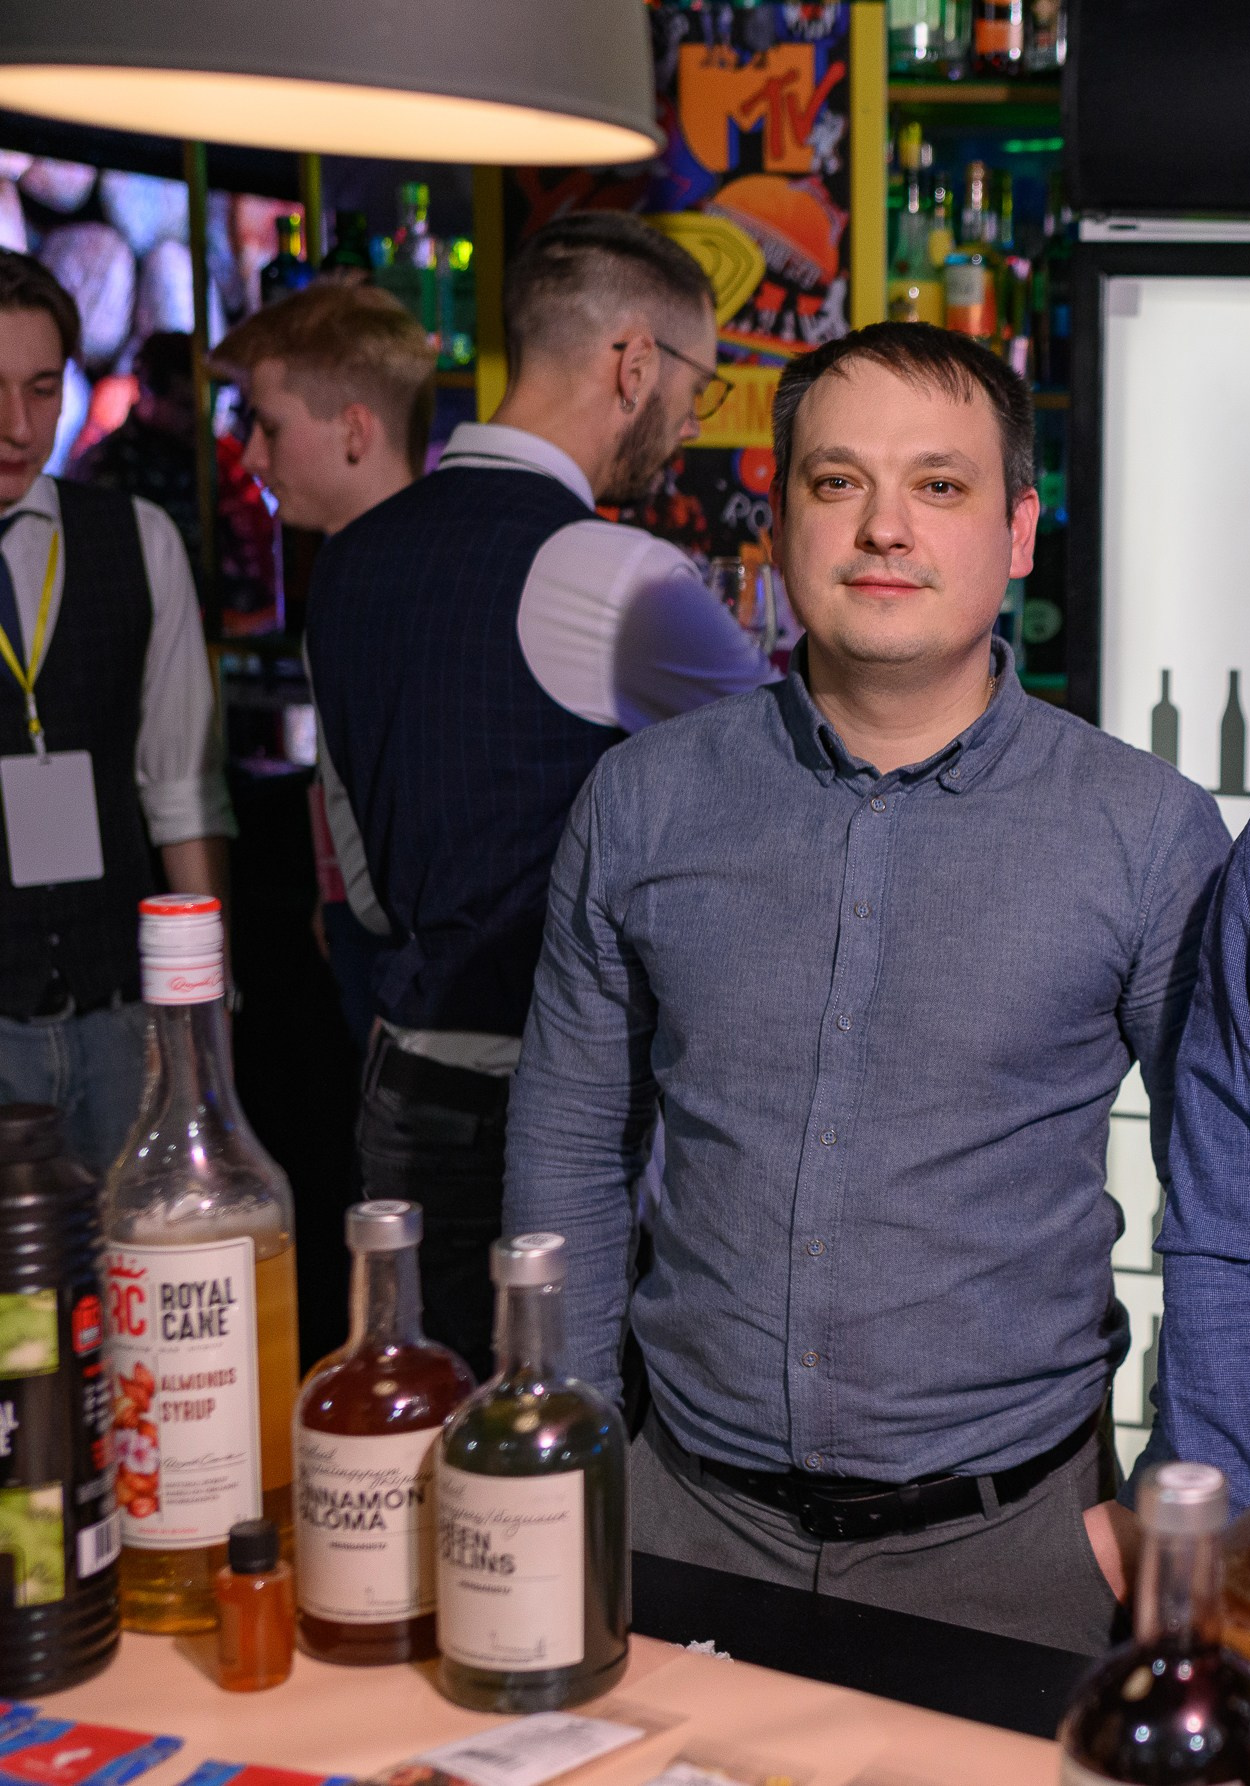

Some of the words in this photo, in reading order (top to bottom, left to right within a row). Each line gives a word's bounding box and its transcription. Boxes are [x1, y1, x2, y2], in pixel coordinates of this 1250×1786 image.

[679, 42, 846, 173] MTV
[160, 1276, 237, 1311] ROYAL
[161, 1307, 231, 1342] CANE
[160, 1367, 238, 1393] ALMONDS
[161, 1397, 217, 1423] SYRUP
